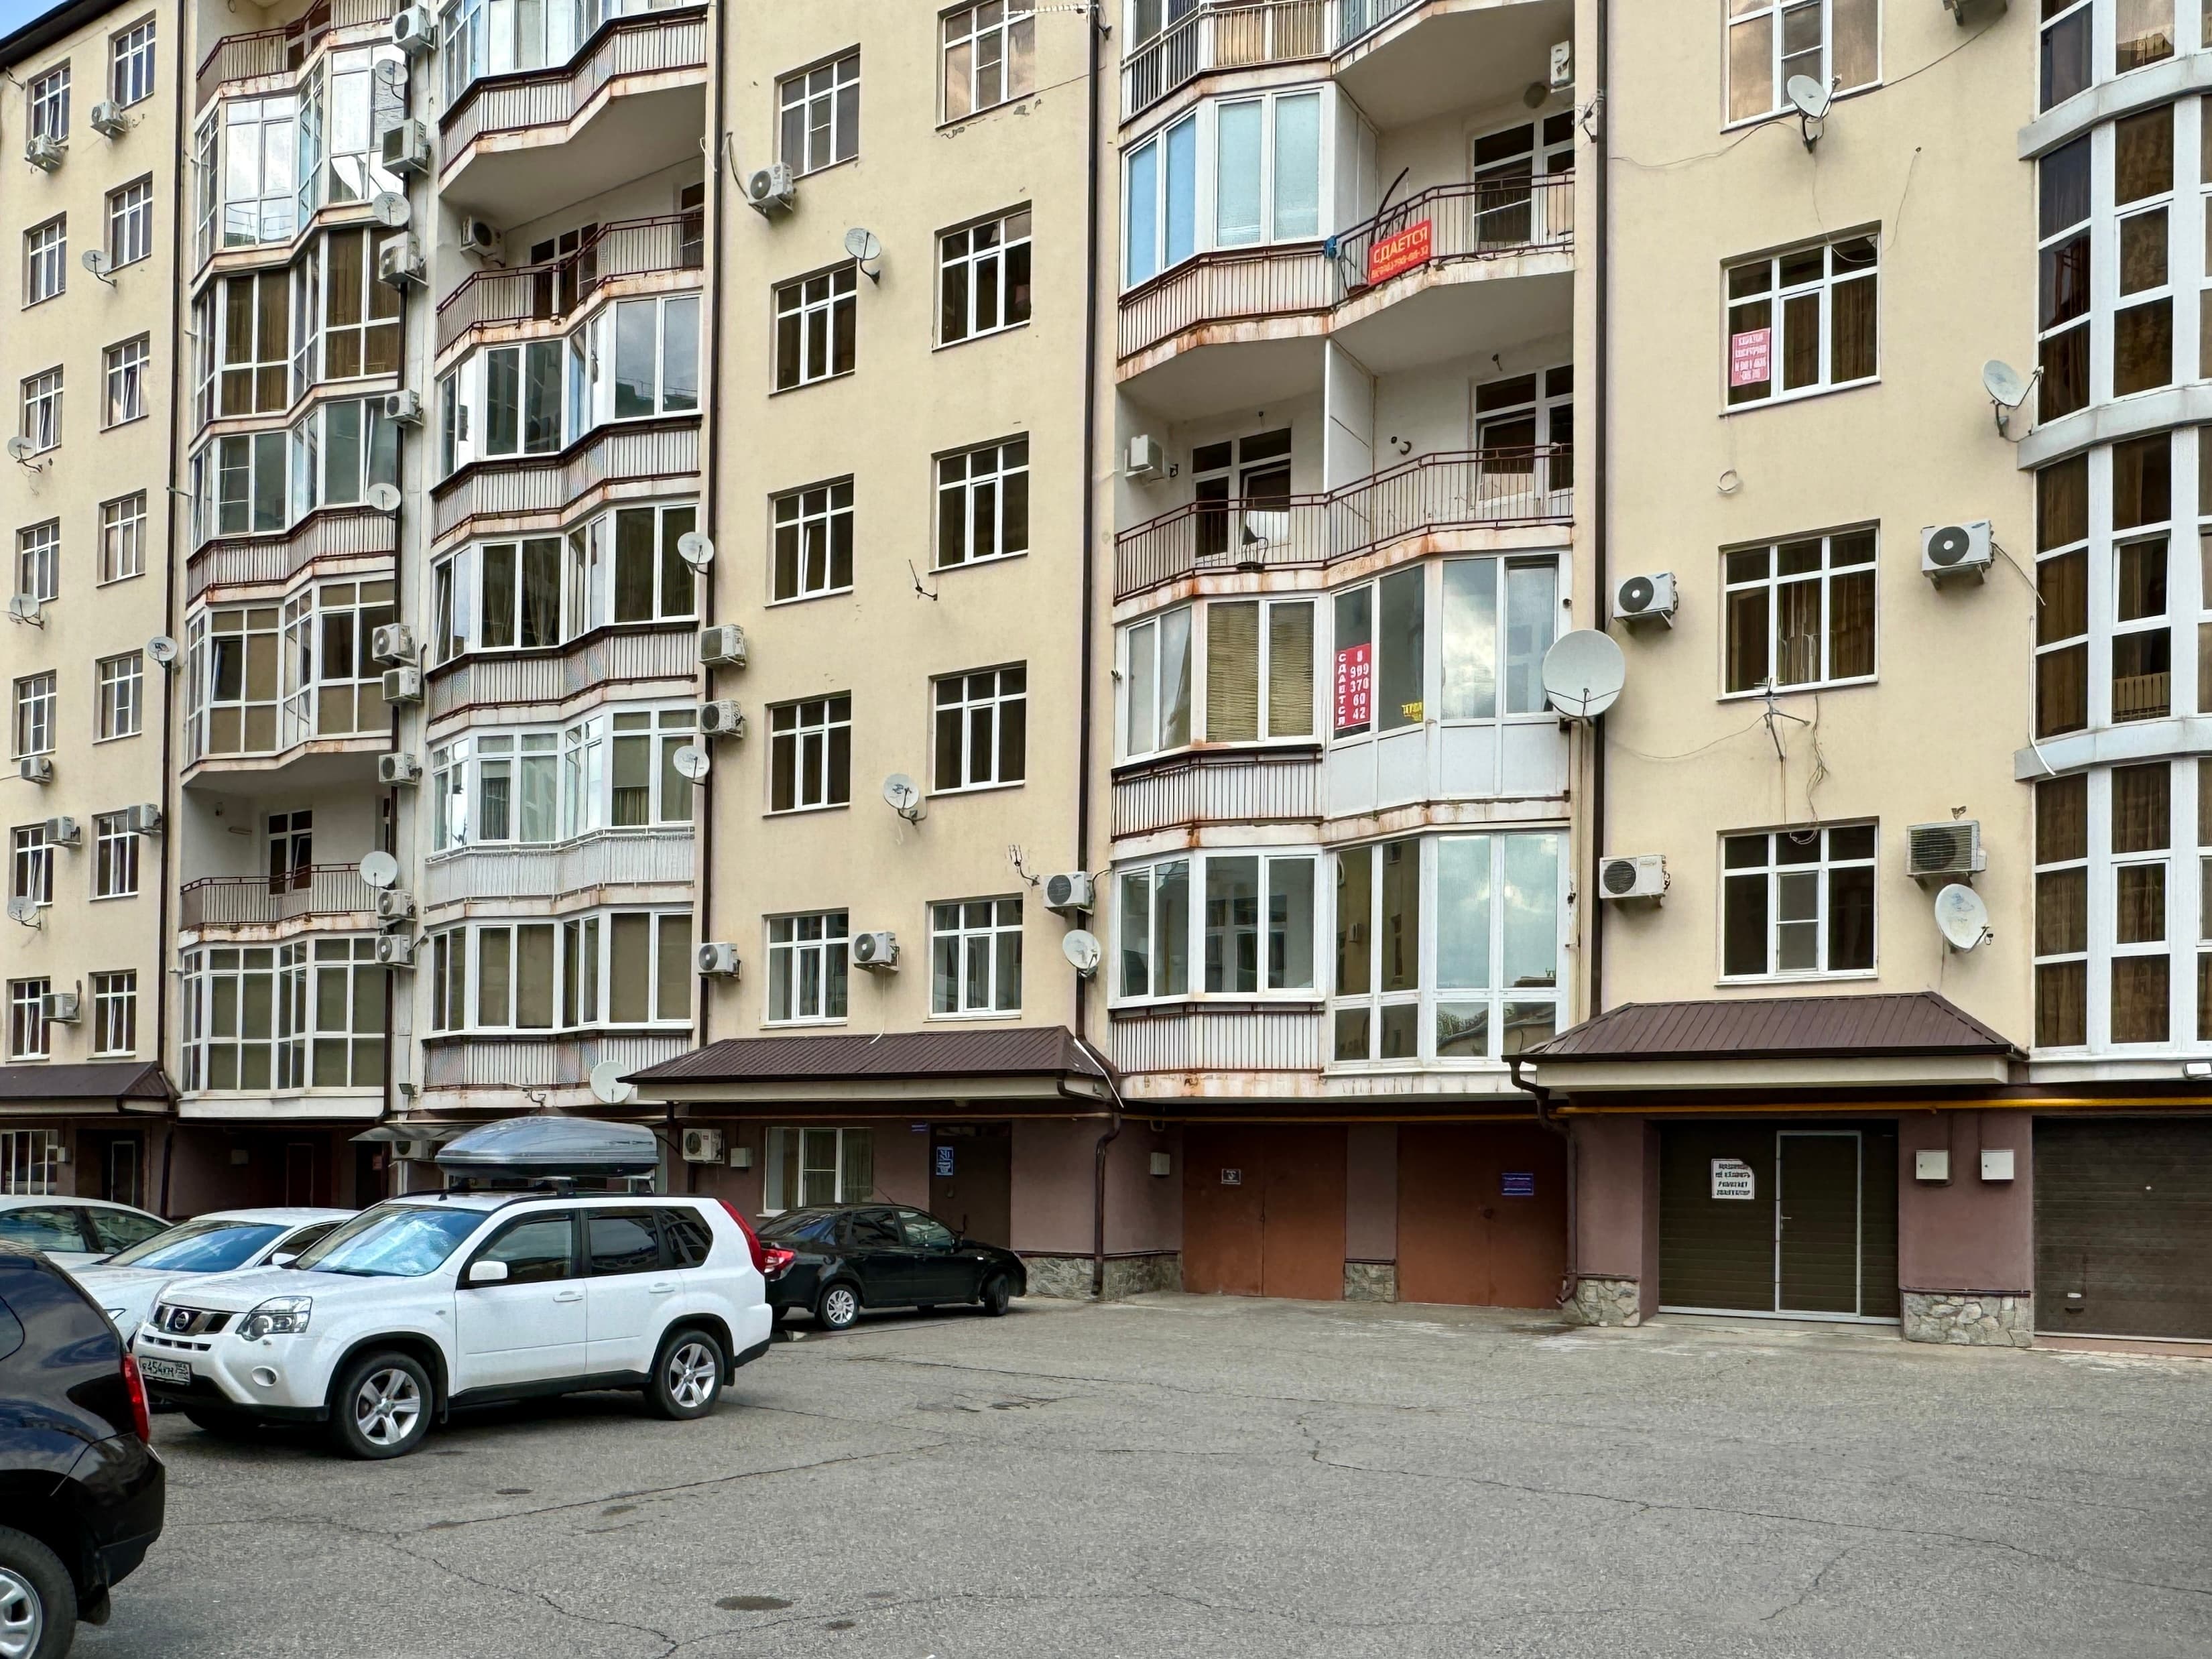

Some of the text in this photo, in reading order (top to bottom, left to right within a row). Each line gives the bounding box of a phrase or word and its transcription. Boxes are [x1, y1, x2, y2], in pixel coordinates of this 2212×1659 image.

[1373, 226, 1428, 263] СДАЕТСЯ
[1338, 653, 1347, 725] СДАЕТСЯ
[1353, 706, 1365, 719] 42
